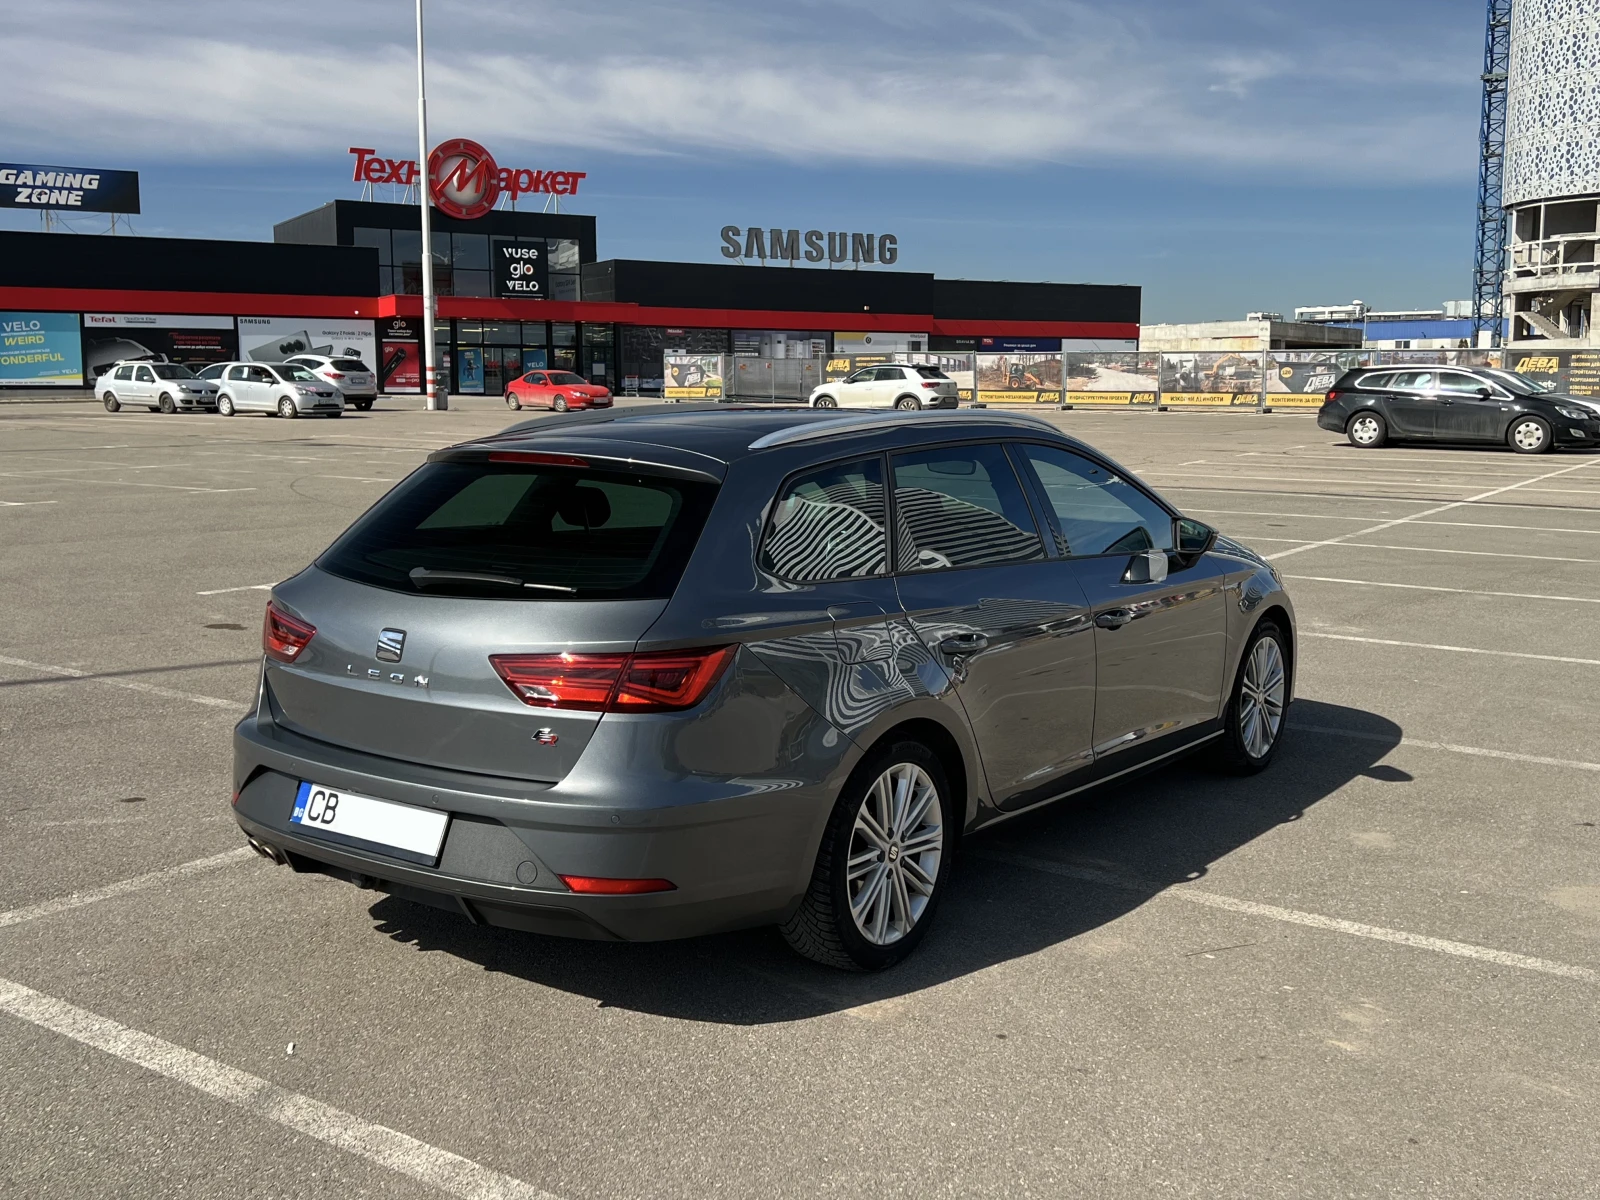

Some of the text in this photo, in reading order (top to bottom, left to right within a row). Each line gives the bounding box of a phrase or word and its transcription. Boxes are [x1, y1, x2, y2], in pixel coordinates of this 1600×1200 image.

[0, 169, 100, 189] GAMING
[15, 188, 84, 206] ZONE
[720, 225, 898, 265] SAMSUNG
[502, 247, 538, 259] vuse
[510, 261, 534, 278] glo
[506, 280, 539, 291] VELO
[2, 320, 40, 332] VELO
[393, 320, 406, 329] glo
[4, 335, 45, 346] WEIRD
[0, 352, 65, 365] ONDERFUL
[1515, 357, 1559, 372] ДЕВА
[1303, 375, 1336, 392] ДЕВА
[347, 664, 430, 688] LEON
[293, 806, 304, 818] BG
[308, 789, 339, 825] CB
